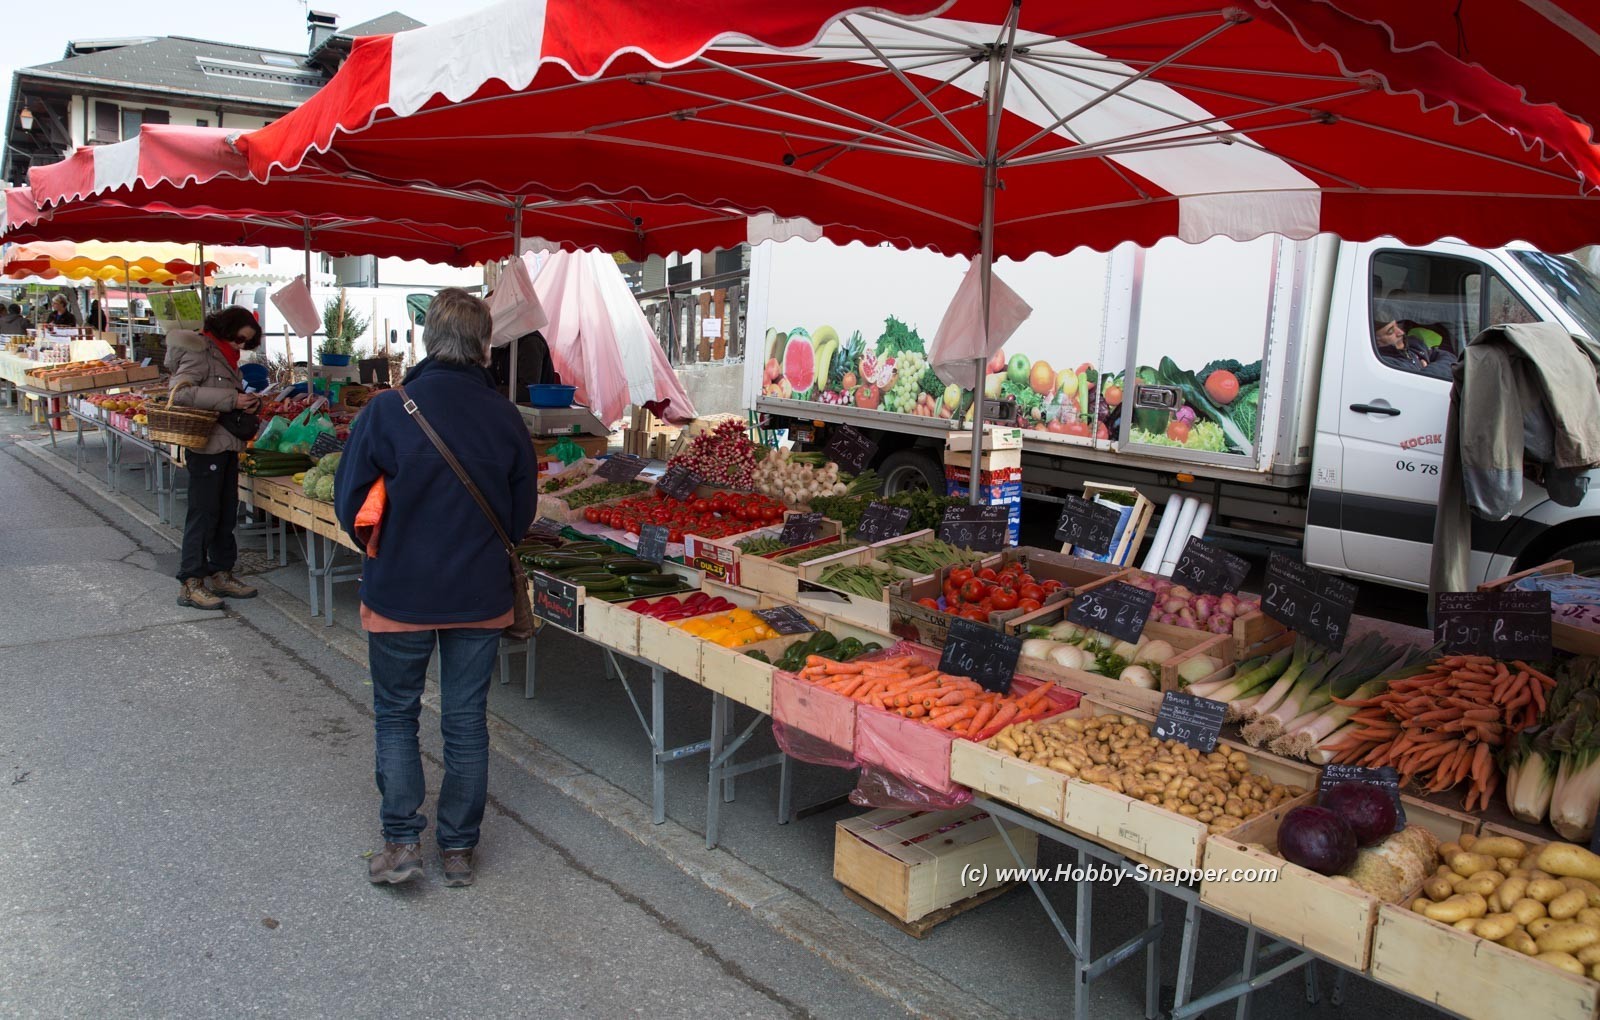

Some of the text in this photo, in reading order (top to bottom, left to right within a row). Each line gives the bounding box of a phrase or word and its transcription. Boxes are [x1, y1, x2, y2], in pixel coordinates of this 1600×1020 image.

[1399, 434, 1442, 451] KOCAK
[1396, 460, 1439, 476] 06 78
[944, 513, 961, 521] Plat
[947, 505, 966, 513] Coco
[991, 528, 1002, 545] kg
[1439, 593, 1485, 602] Carotte
[1440, 600, 1473, 611] Fane
[1115, 604, 1129, 625] le
[1130, 610, 1144, 633] kg
[1309, 602, 1321, 626] le
[1326, 615, 1342, 641] kg
[1492, 618, 1509, 643] la
